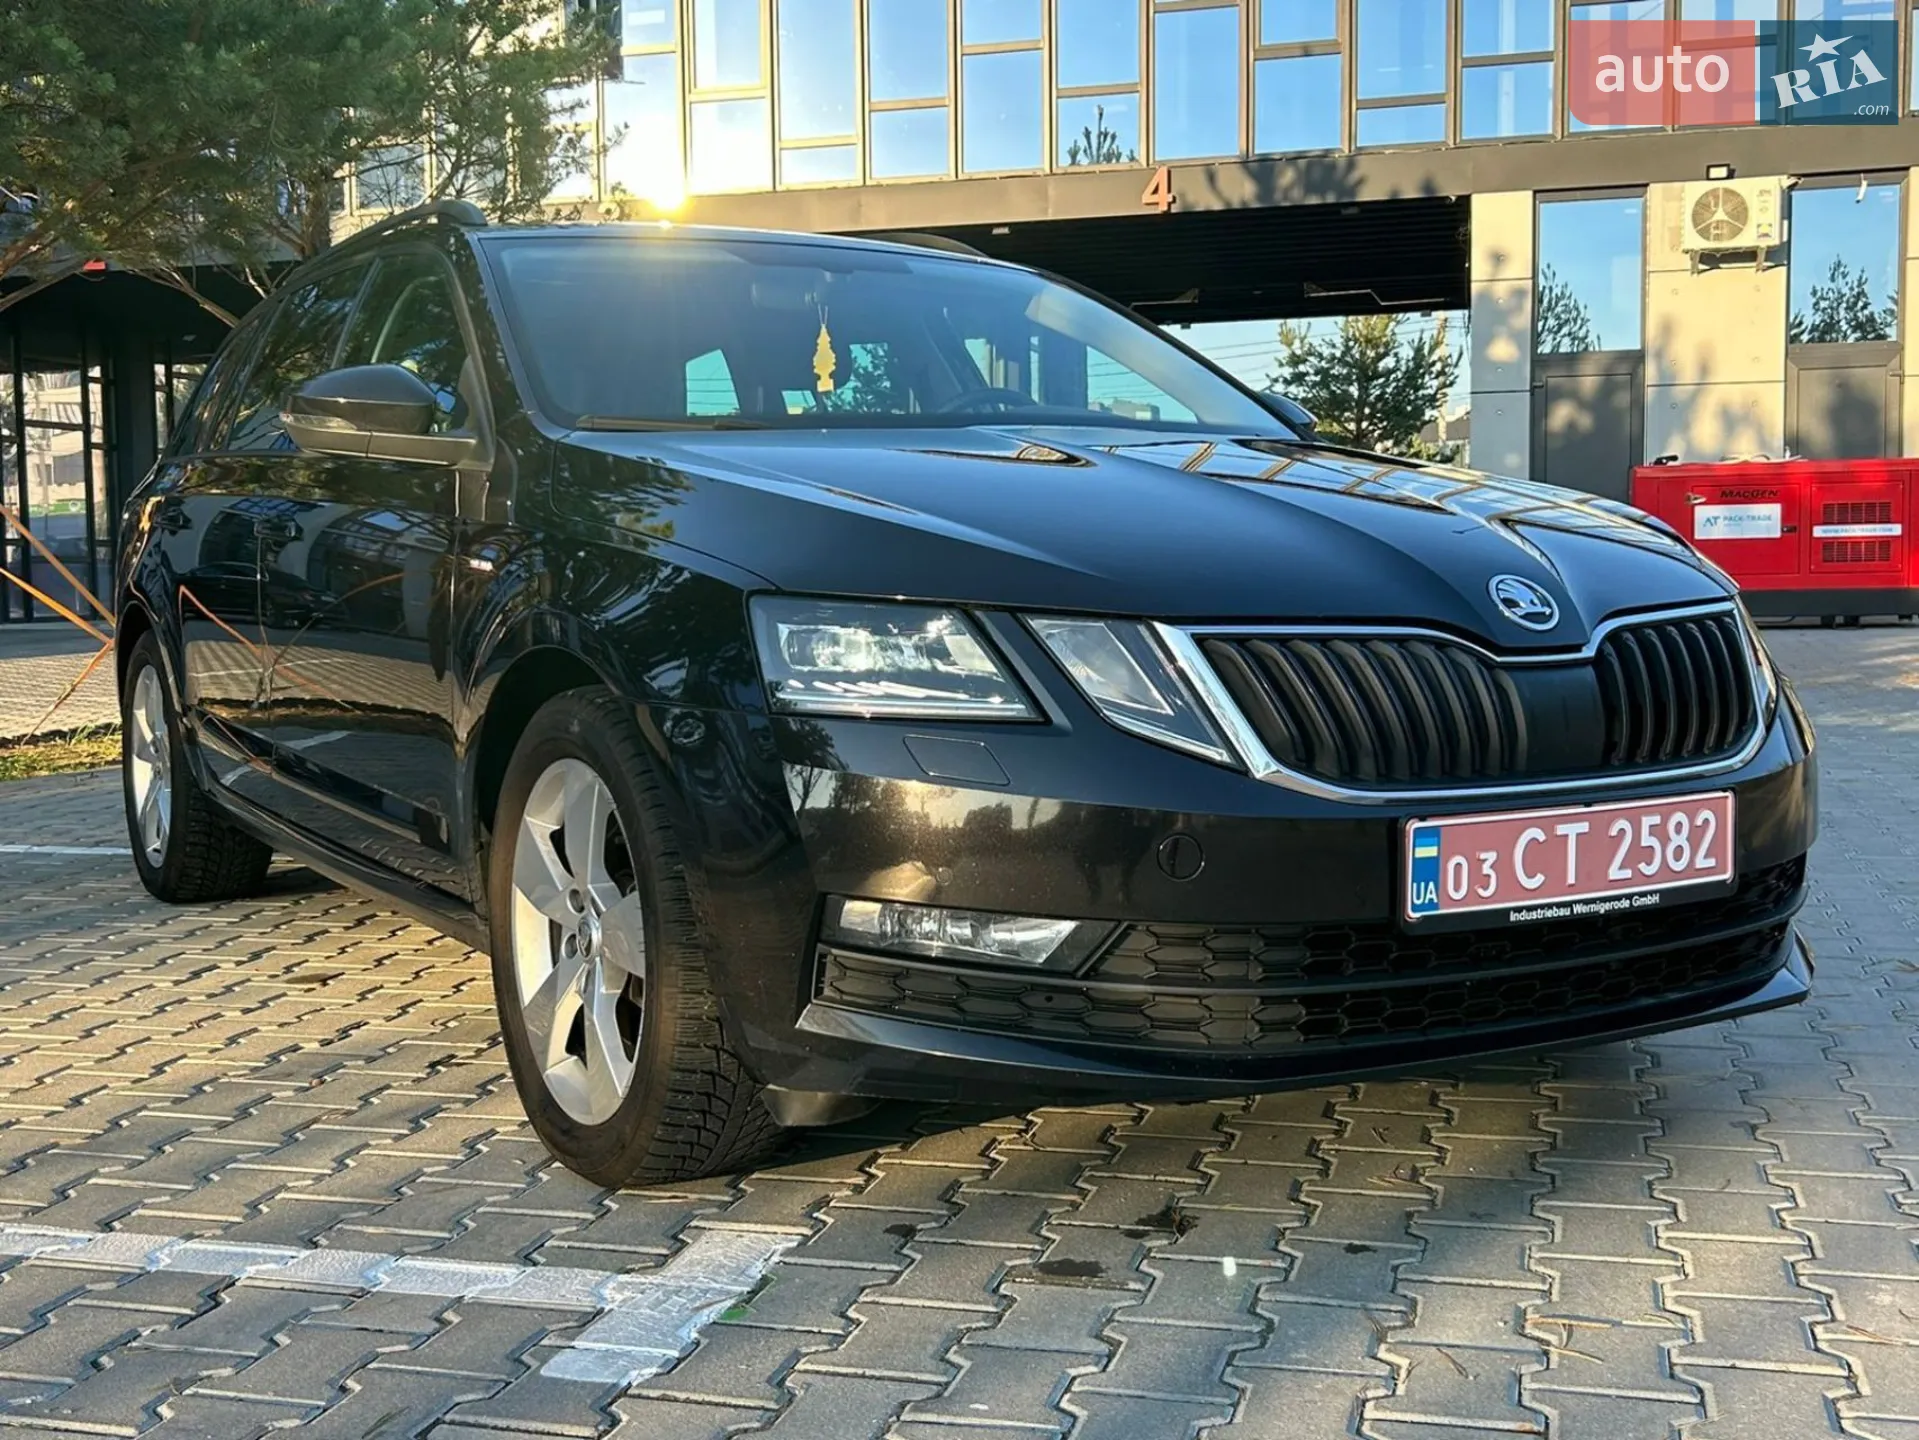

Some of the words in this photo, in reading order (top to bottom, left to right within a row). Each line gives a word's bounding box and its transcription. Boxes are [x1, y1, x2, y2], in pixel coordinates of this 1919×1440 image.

[1142, 165, 1176, 213] 4
[1703, 515, 1721, 528] AT
[1446, 850, 1498, 901] 03
[1513, 821, 1590, 890] CT
[1607, 808, 1717, 882] 2582
[1412, 881, 1438, 905] UA
[1509, 906, 1571, 922] Industriebau
[1572, 897, 1630, 914] Wernigerode
[1631, 893, 1660, 907] GmbH
